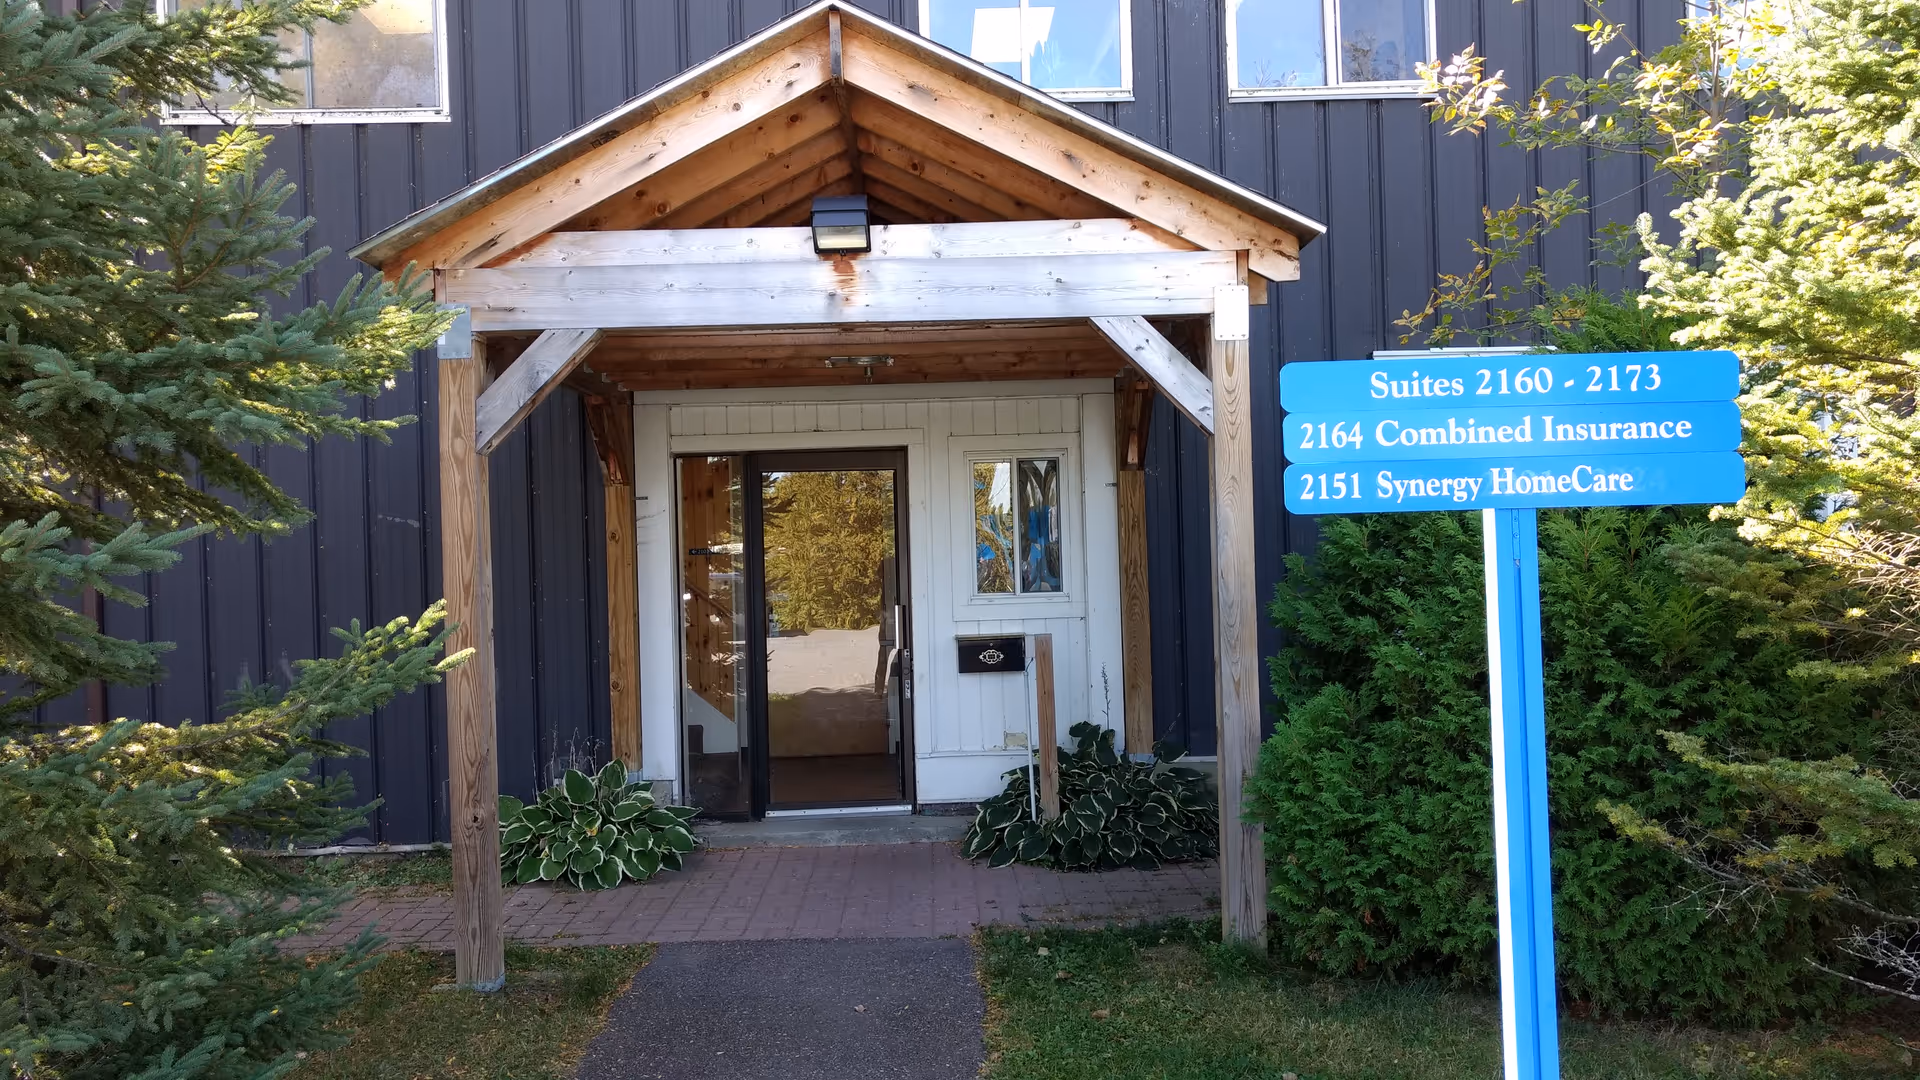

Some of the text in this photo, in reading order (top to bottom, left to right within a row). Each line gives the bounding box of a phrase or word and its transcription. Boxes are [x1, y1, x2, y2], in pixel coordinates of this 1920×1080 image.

[1371, 363, 1661, 399] Suites 2160 - 2173
[1300, 415, 1692, 450] 2164 Combined Insurance
[1300, 471, 1362, 500] 2151
[1377, 471, 1483, 503] Synergy
[1490, 464, 1634, 495] HomeCare
